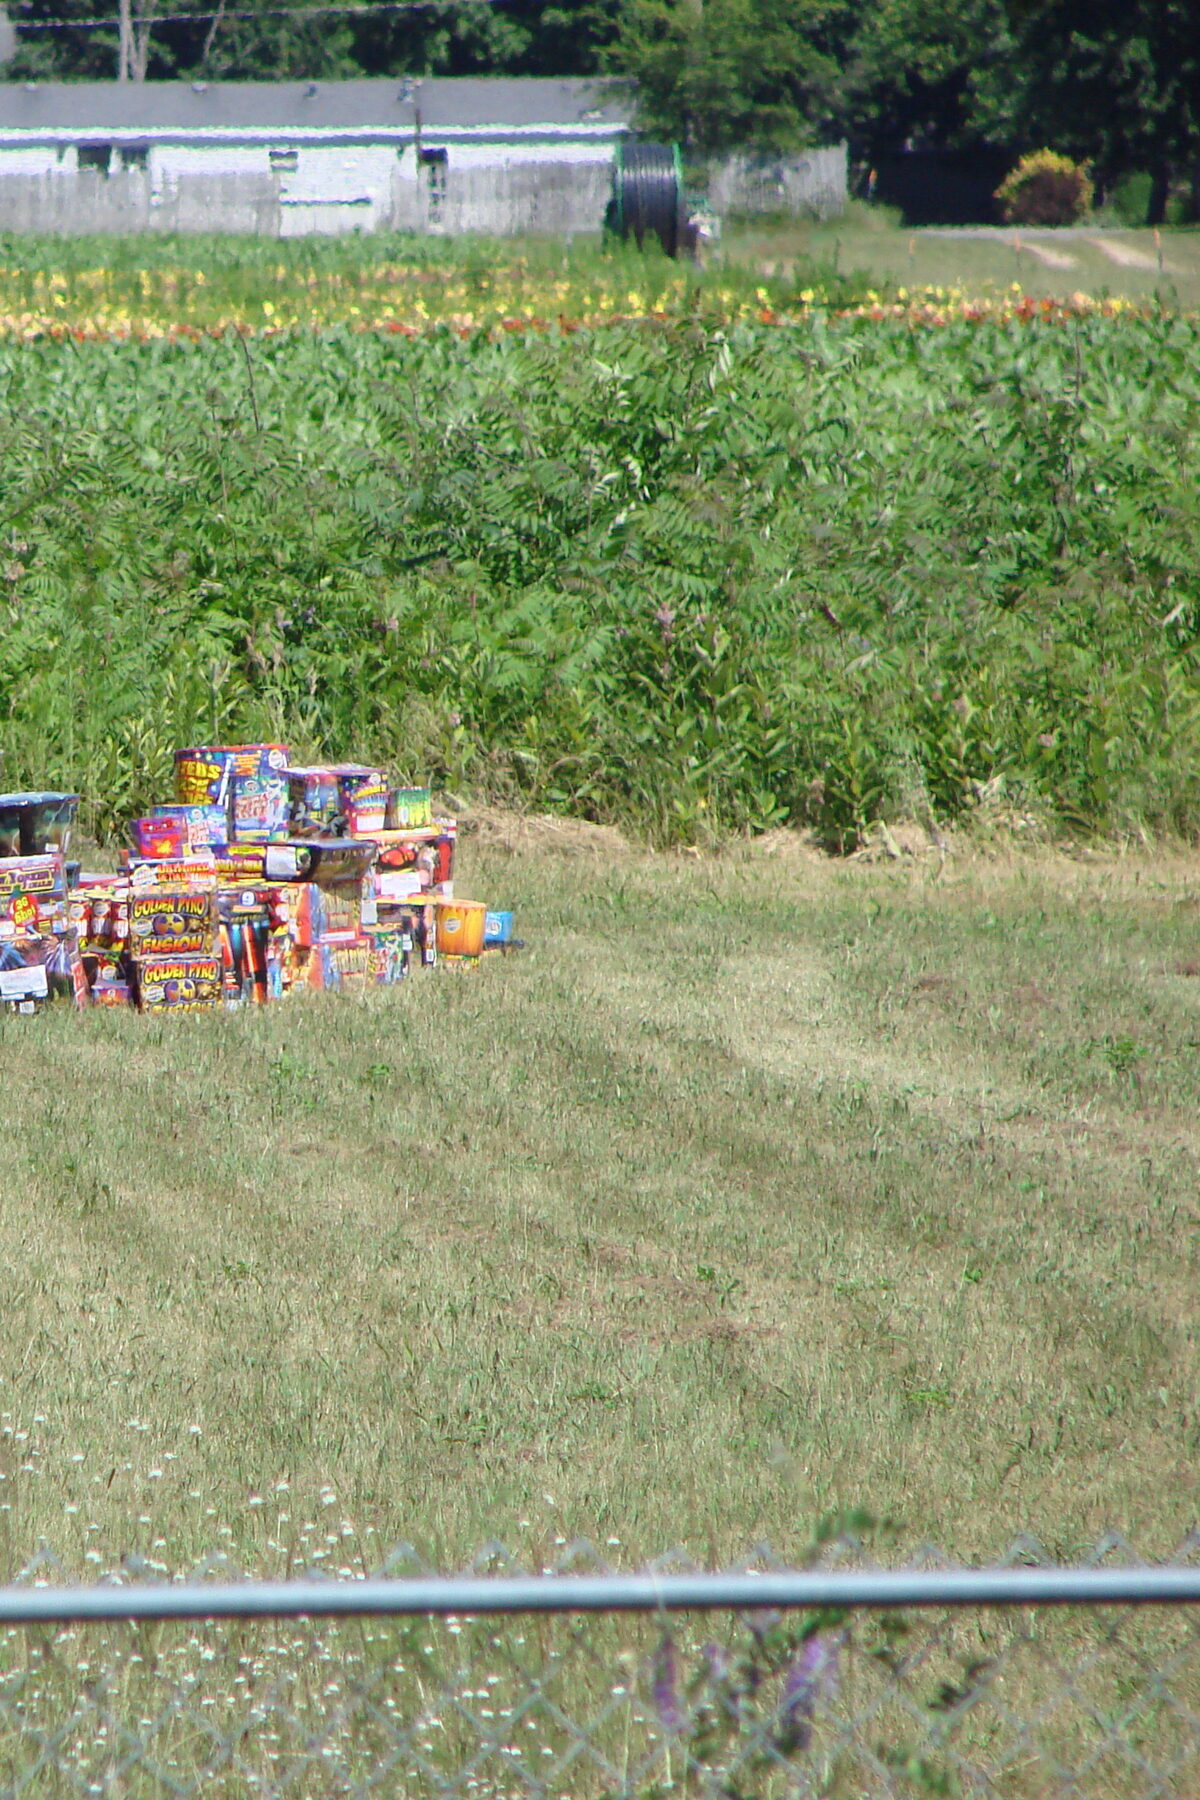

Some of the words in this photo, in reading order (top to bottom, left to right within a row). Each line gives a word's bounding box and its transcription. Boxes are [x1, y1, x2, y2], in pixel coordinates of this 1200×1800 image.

[133, 896, 175, 918] GOLDEN
[177, 894, 205, 916] PYRO
[141, 935, 203, 954] FUSION
[144, 961, 186, 984] GOLDEN
[188, 960, 217, 981] PYRO
